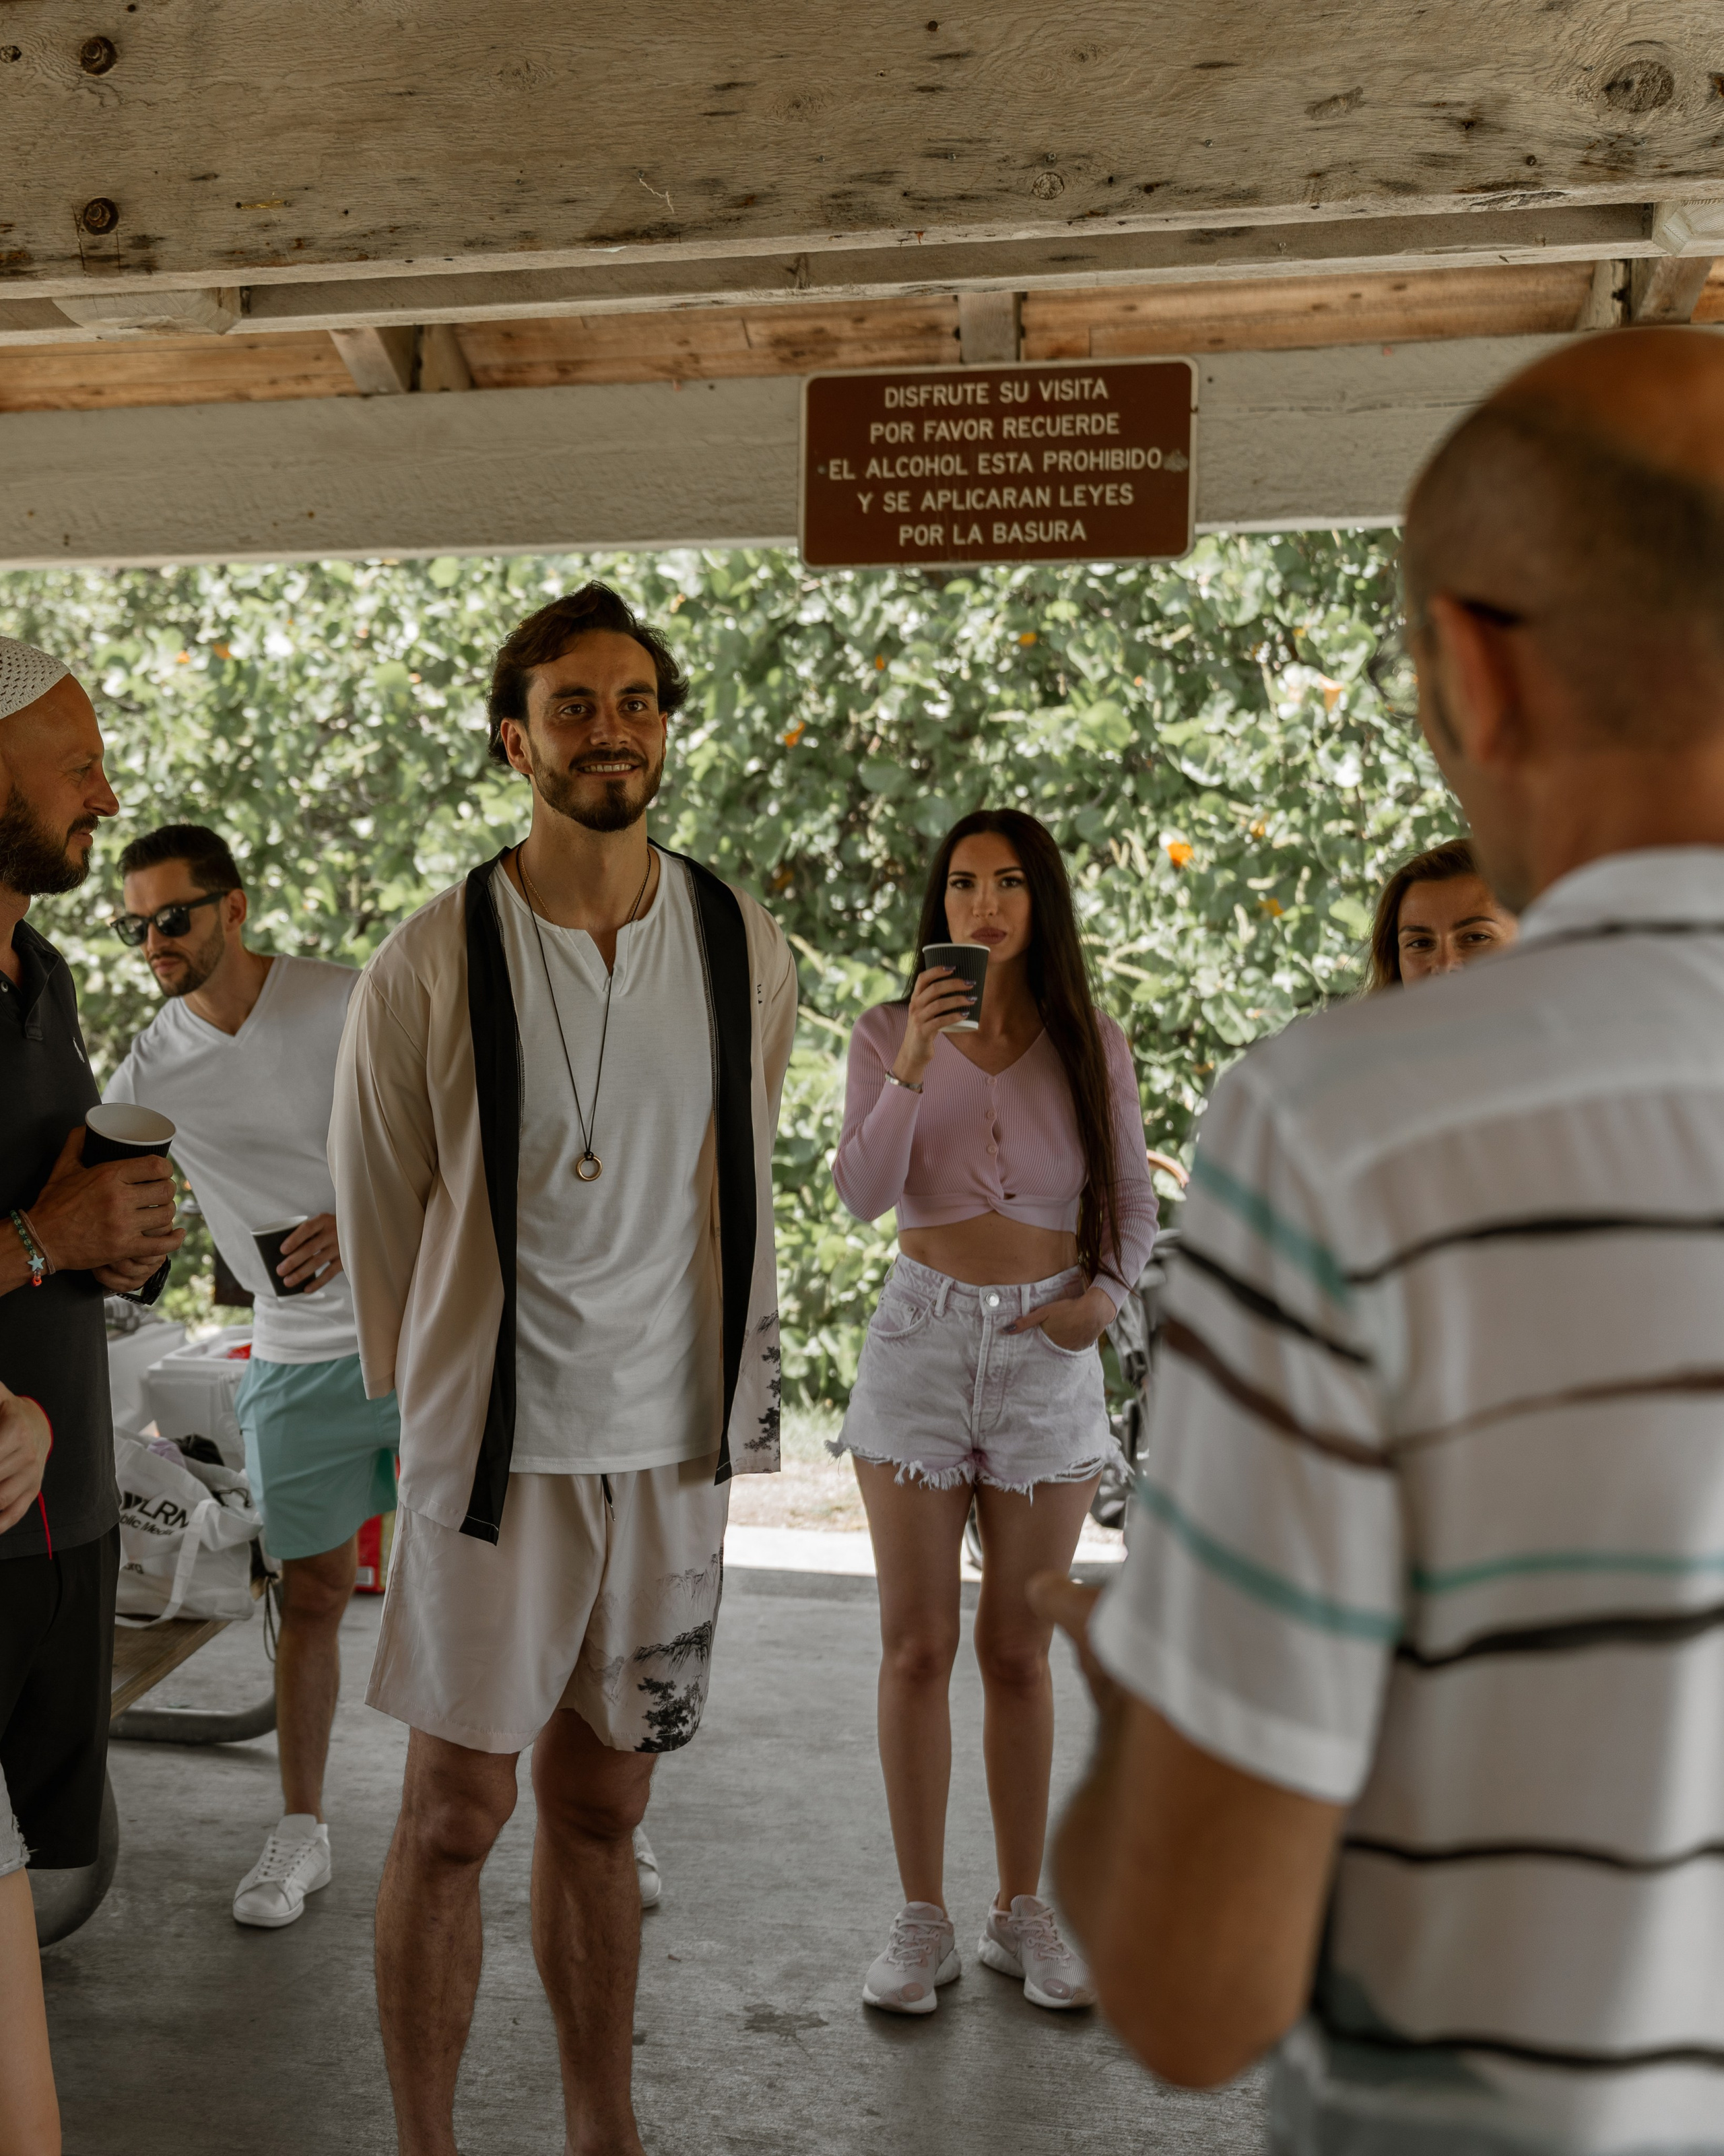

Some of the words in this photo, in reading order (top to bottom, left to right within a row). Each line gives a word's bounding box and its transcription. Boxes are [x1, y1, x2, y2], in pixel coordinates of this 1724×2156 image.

[884, 382, 989, 408] DISFRUTE
[999, 381, 1029, 403] SU
[1039, 378, 1108, 401] VISITA
[870, 421, 915, 445] POR
[923, 418, 993, 442] FAVOR
[1003, 412, 1120, 439] RECUERDE
[829, 458, 856, 480] EL
[865, 453, 968, 480] ALCOHOL
[978, 451, 1034, 475] ESTA
[1043, 447, 1162, 473] PROHIBIDO
[857, 492, 873, 513] Y
[883, 490, 910, 513] SE
[920, 486, 1051, 512] APLICARAN
[1059, 483, 1134, 507] LEYES
[899, 524, 944, 546] POR
[953, 523, 983, 546] LA
[993, 519, 1086, 544] BASURA
[120, 1513, 141, 1528] blic
